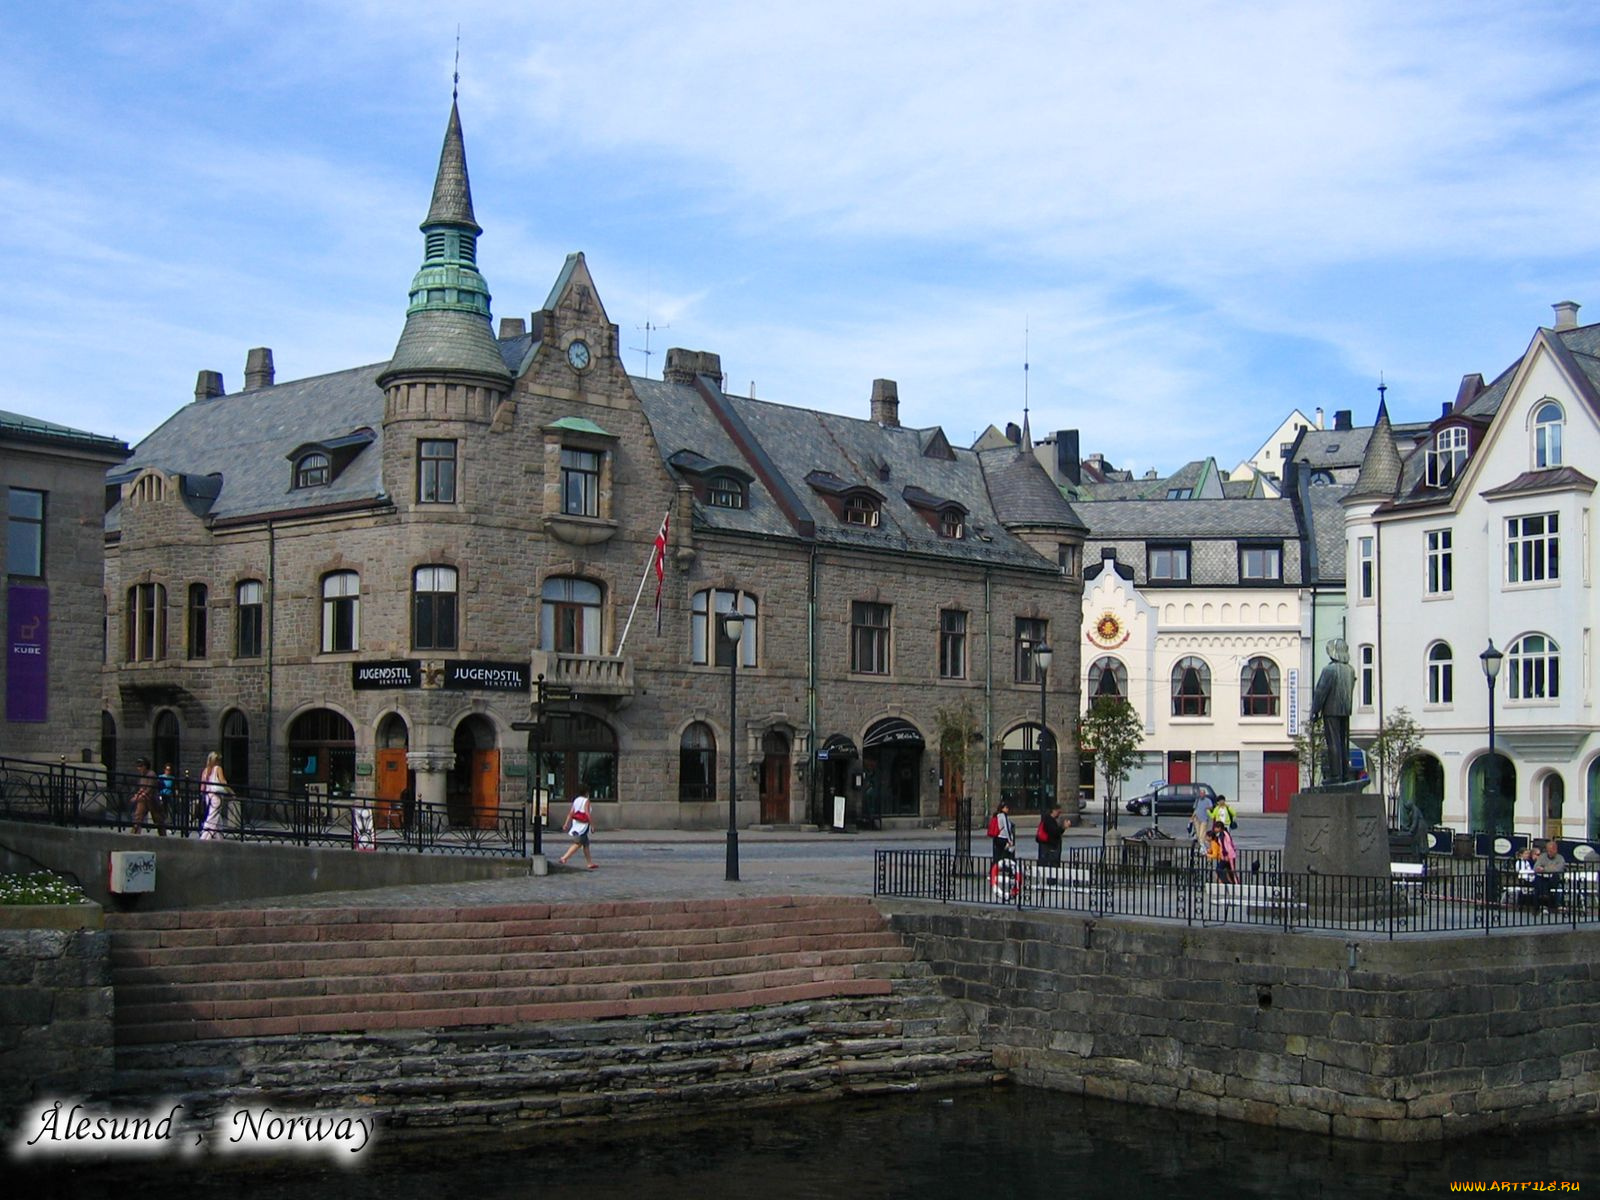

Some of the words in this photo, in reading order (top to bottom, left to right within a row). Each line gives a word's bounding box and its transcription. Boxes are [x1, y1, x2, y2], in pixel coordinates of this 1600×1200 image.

[14, 647, 41, 655] KUBE
[359, 667, 411, 679] JUGENDSTIL
[454, 668, 521, 681] JUGENDSTIL
